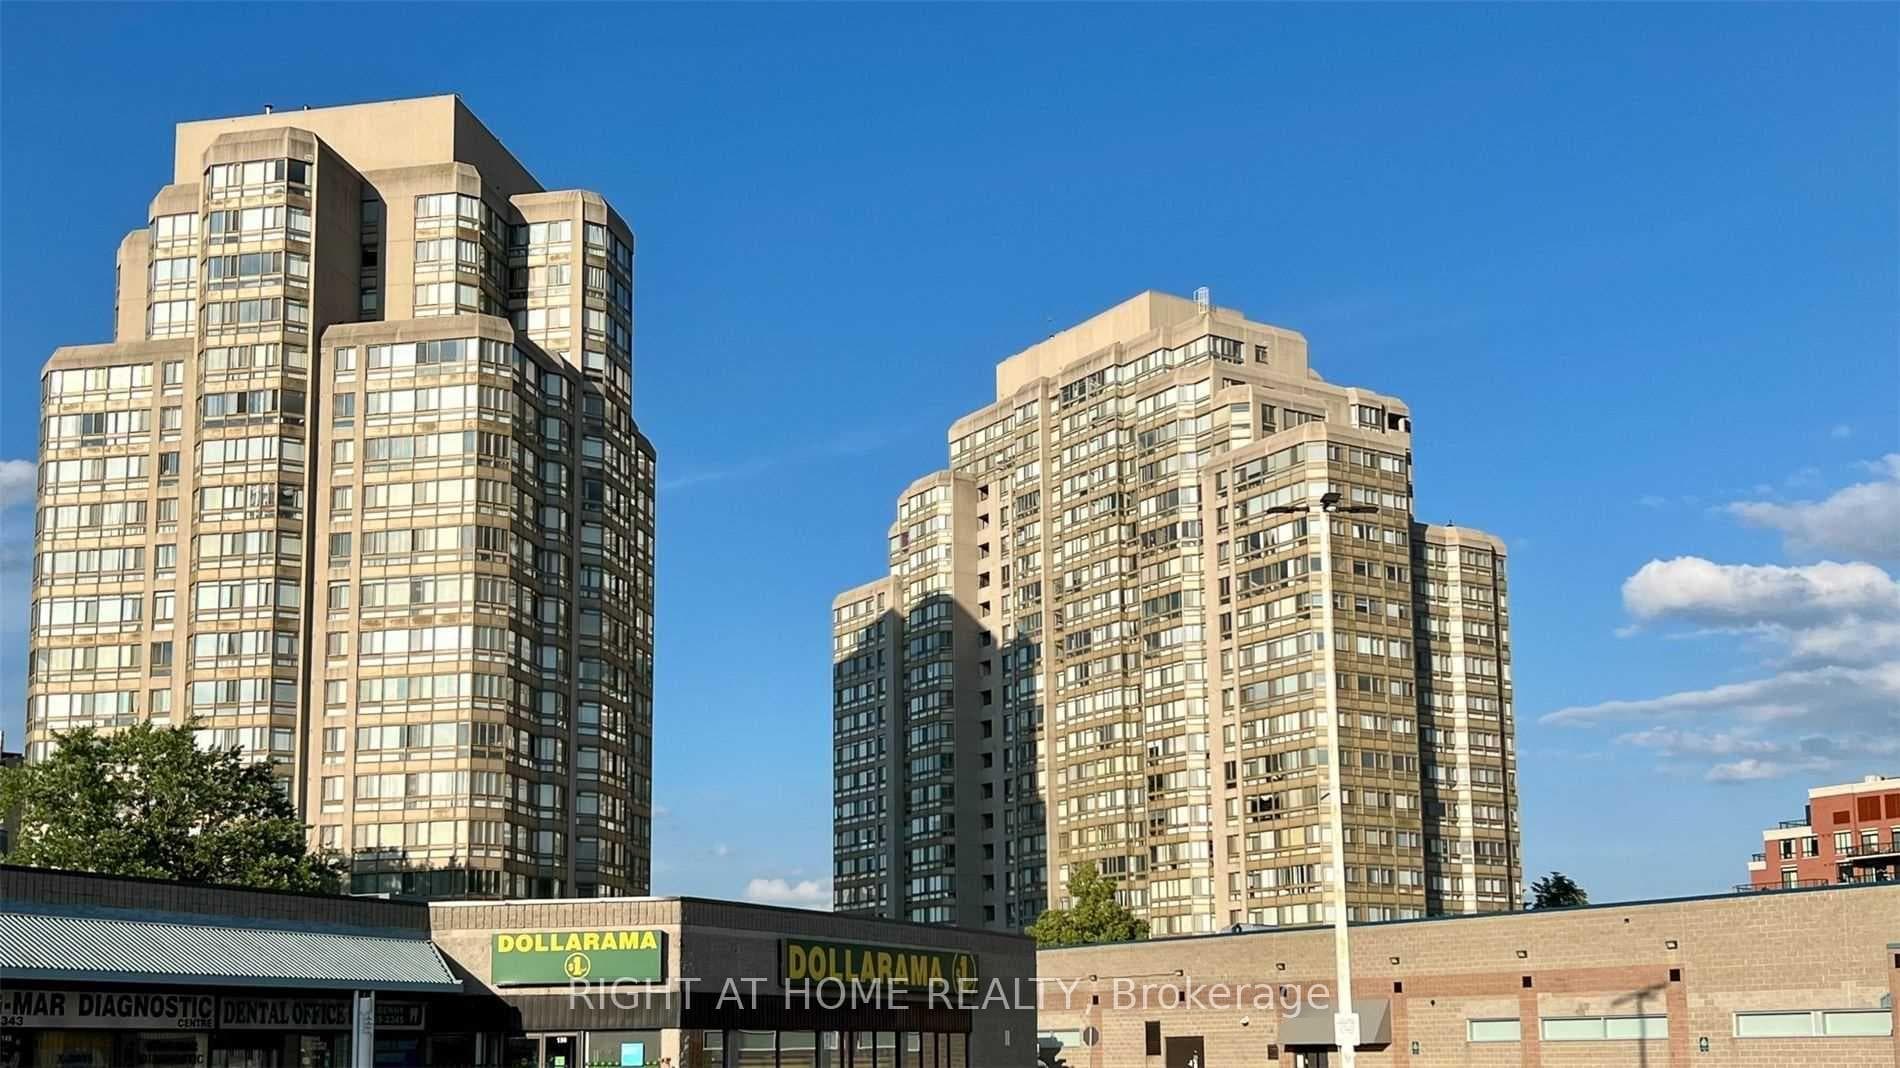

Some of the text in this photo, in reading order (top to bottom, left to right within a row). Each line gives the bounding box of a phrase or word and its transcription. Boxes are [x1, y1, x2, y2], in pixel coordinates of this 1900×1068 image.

[498, 931, 657, 953] DOLLARAMA
[788, 944, 944, 987] DOLLARAMA
[0, 992, 212, 1018] -MAR DIAGNOSTIC
[223, 1001, 289, 1024] DENTAL
[292, 1003, 346, 1025] OFFICE
